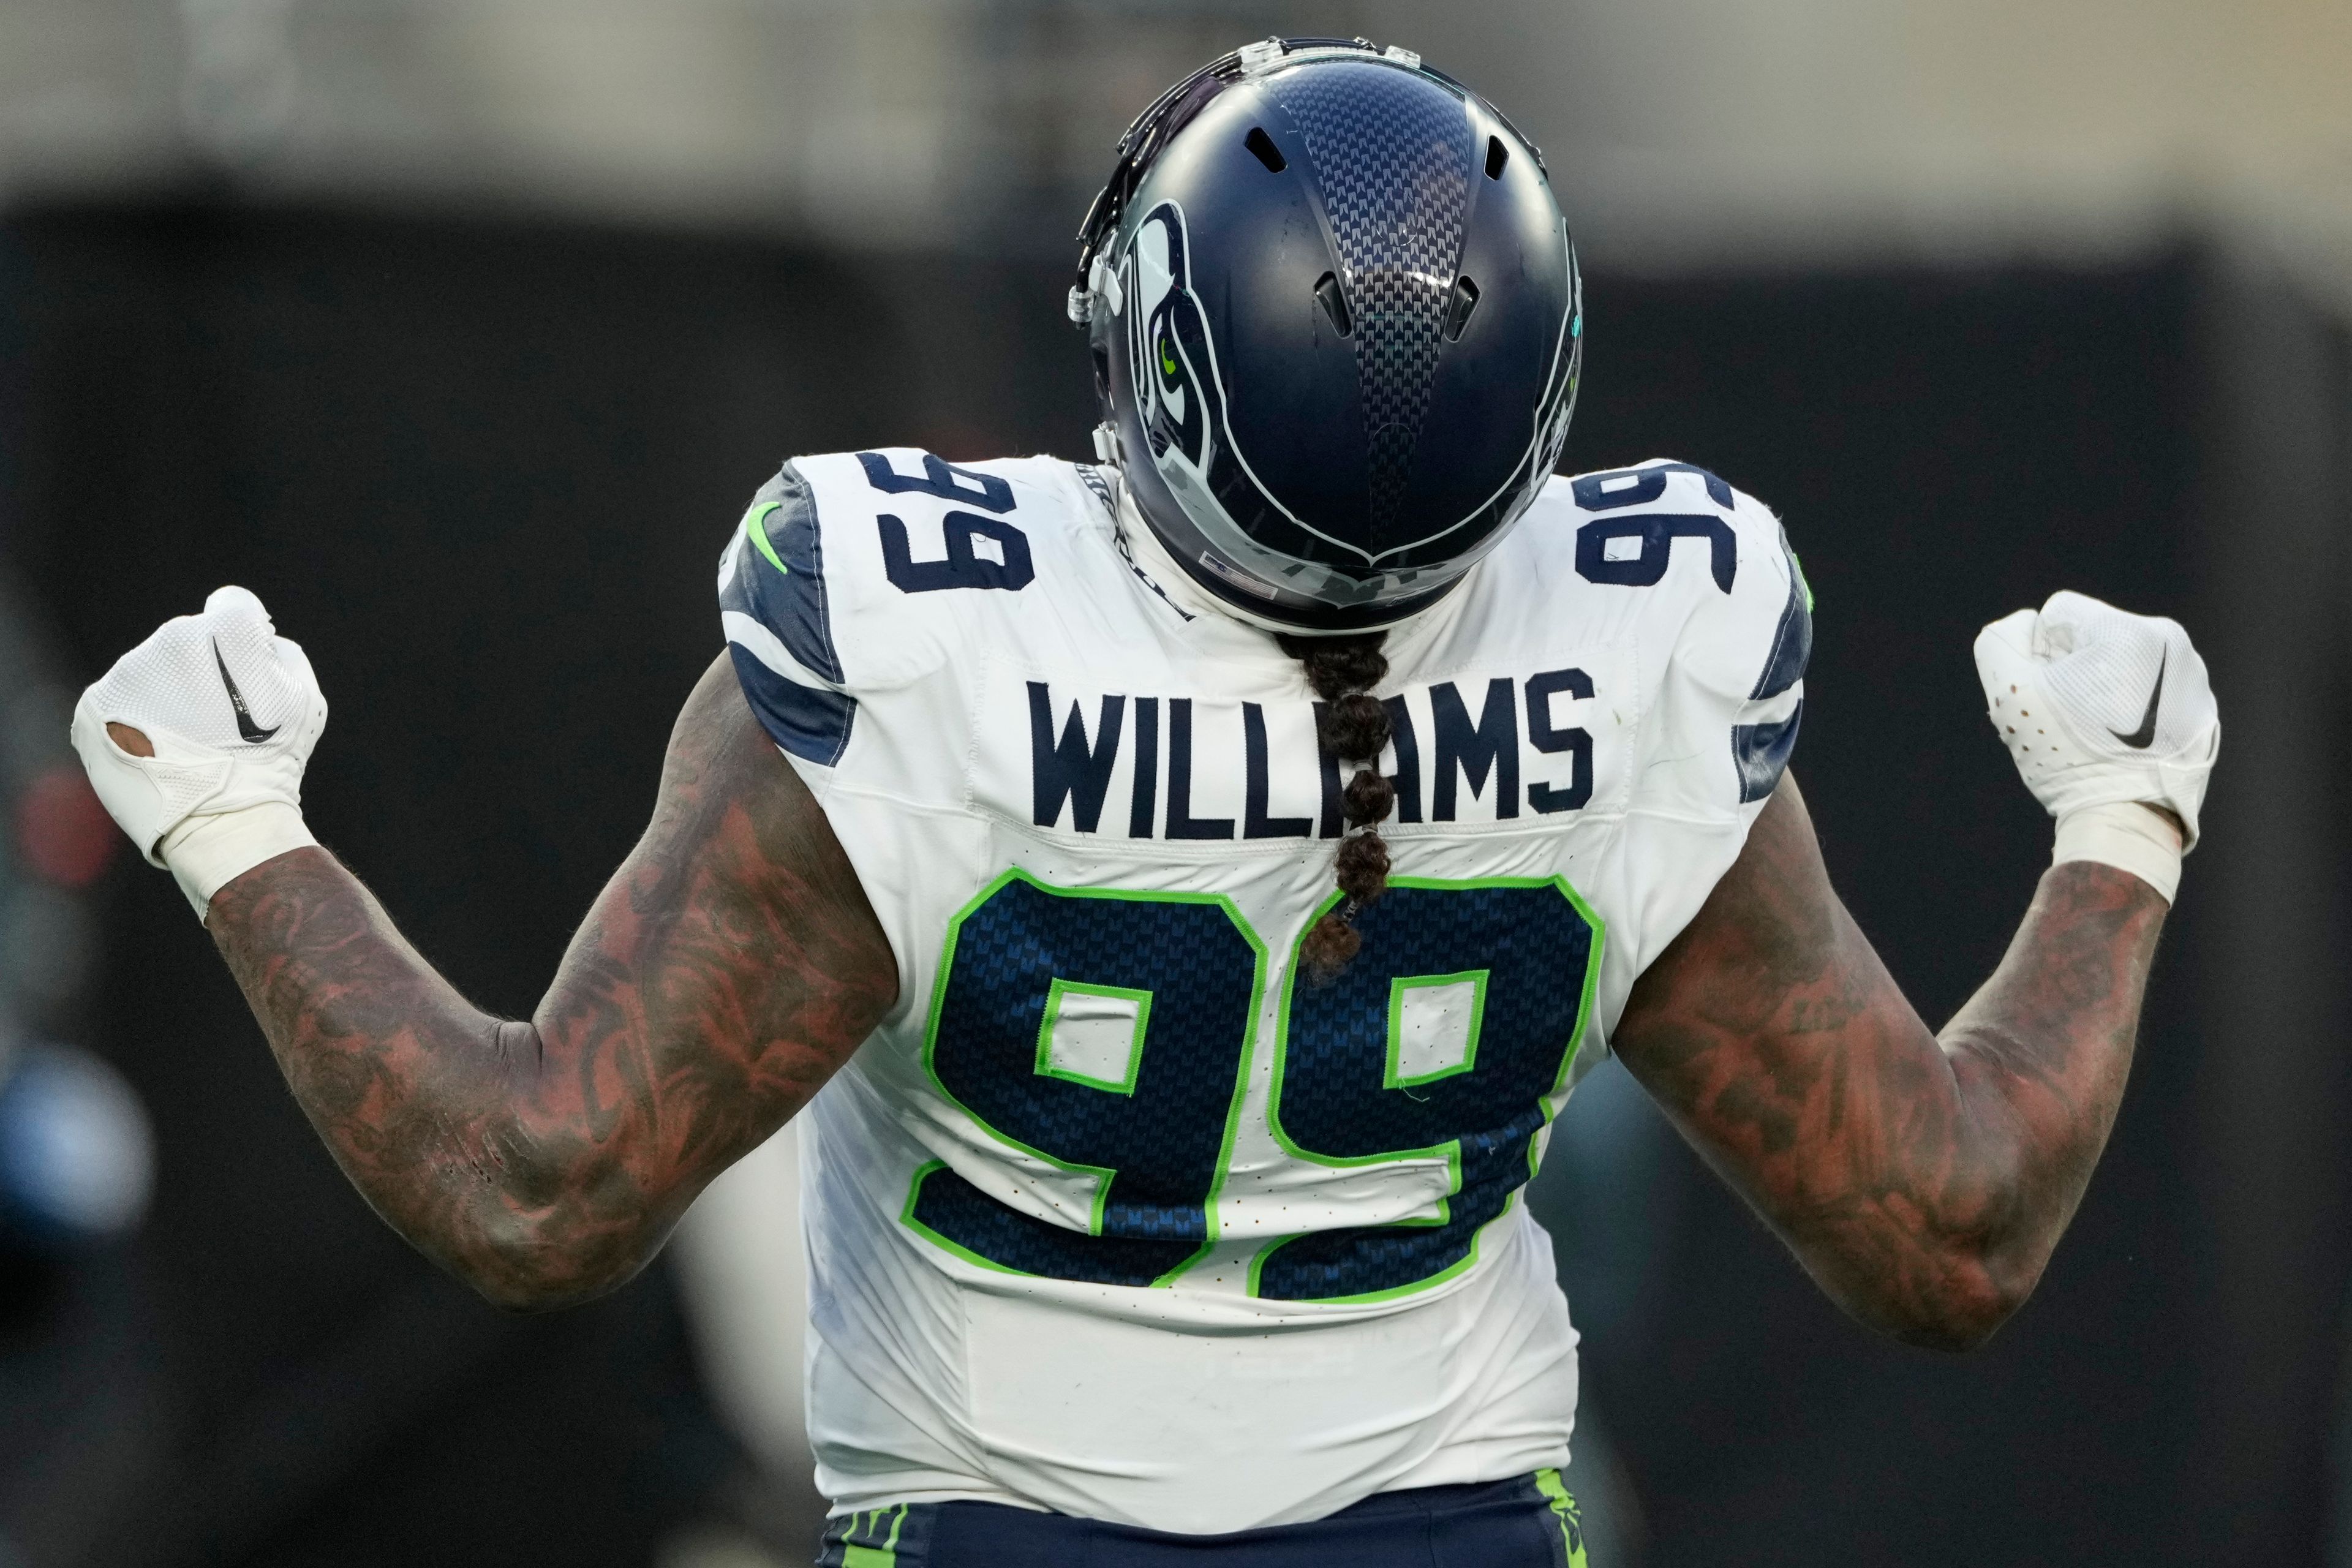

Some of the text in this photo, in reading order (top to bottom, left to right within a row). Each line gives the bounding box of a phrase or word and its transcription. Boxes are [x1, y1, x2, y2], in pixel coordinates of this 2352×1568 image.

[855, 453, 1035, 594] 99
[1571, 463, 1737, 595] 99
[1027, 666, 1595, 840] WILLIAMS
[900, 868, 1602, 1303] 99
